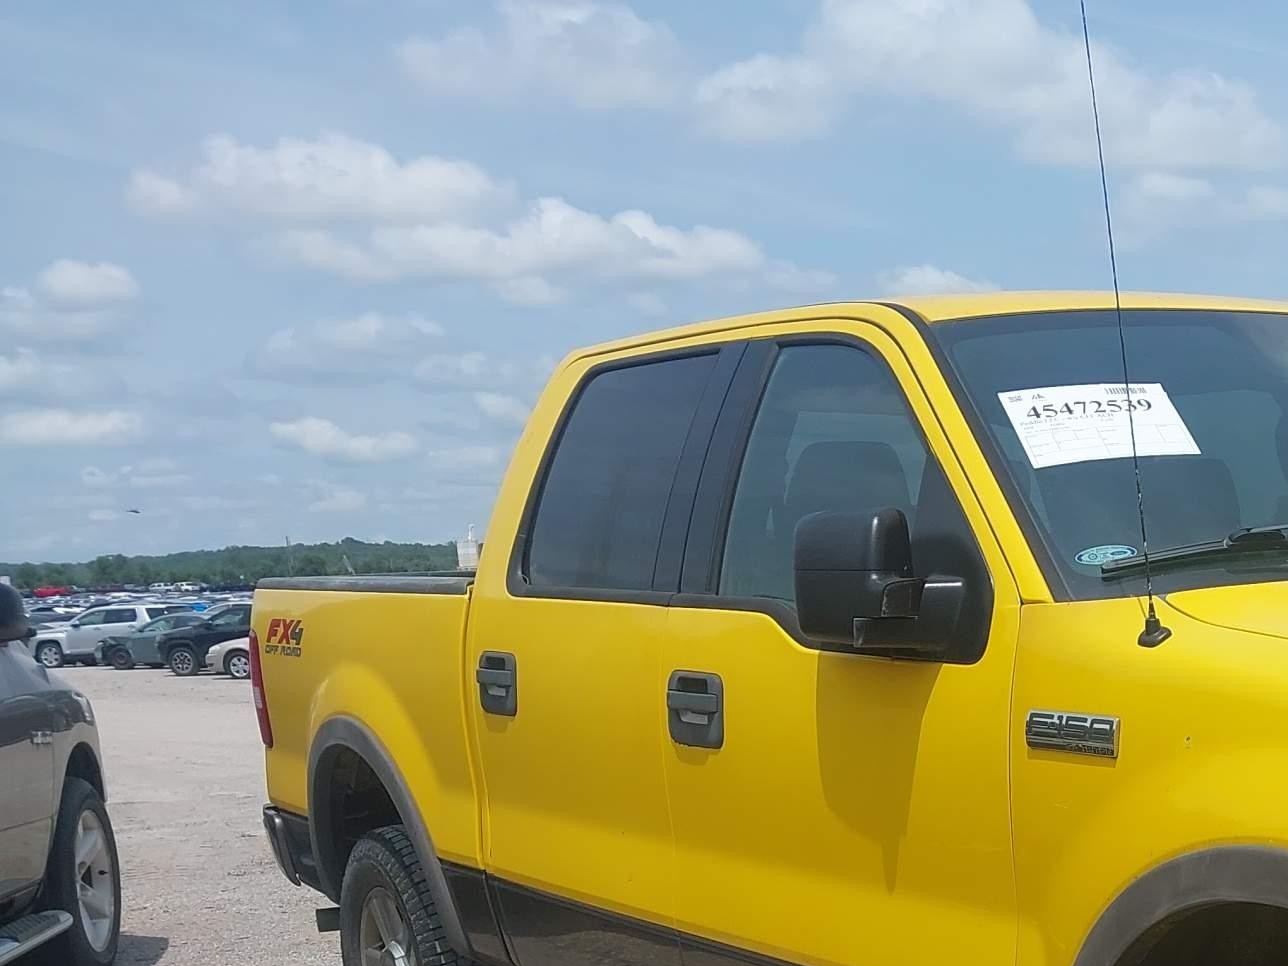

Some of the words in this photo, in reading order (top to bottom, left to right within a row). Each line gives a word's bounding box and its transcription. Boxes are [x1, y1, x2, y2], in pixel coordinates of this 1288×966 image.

[1027, 398, 1152, 419] 45472539
[266, 618, 304, 645] FX4
[264, 645, 279, 655] OFF
[280, 645, 302, 658] ROAD
